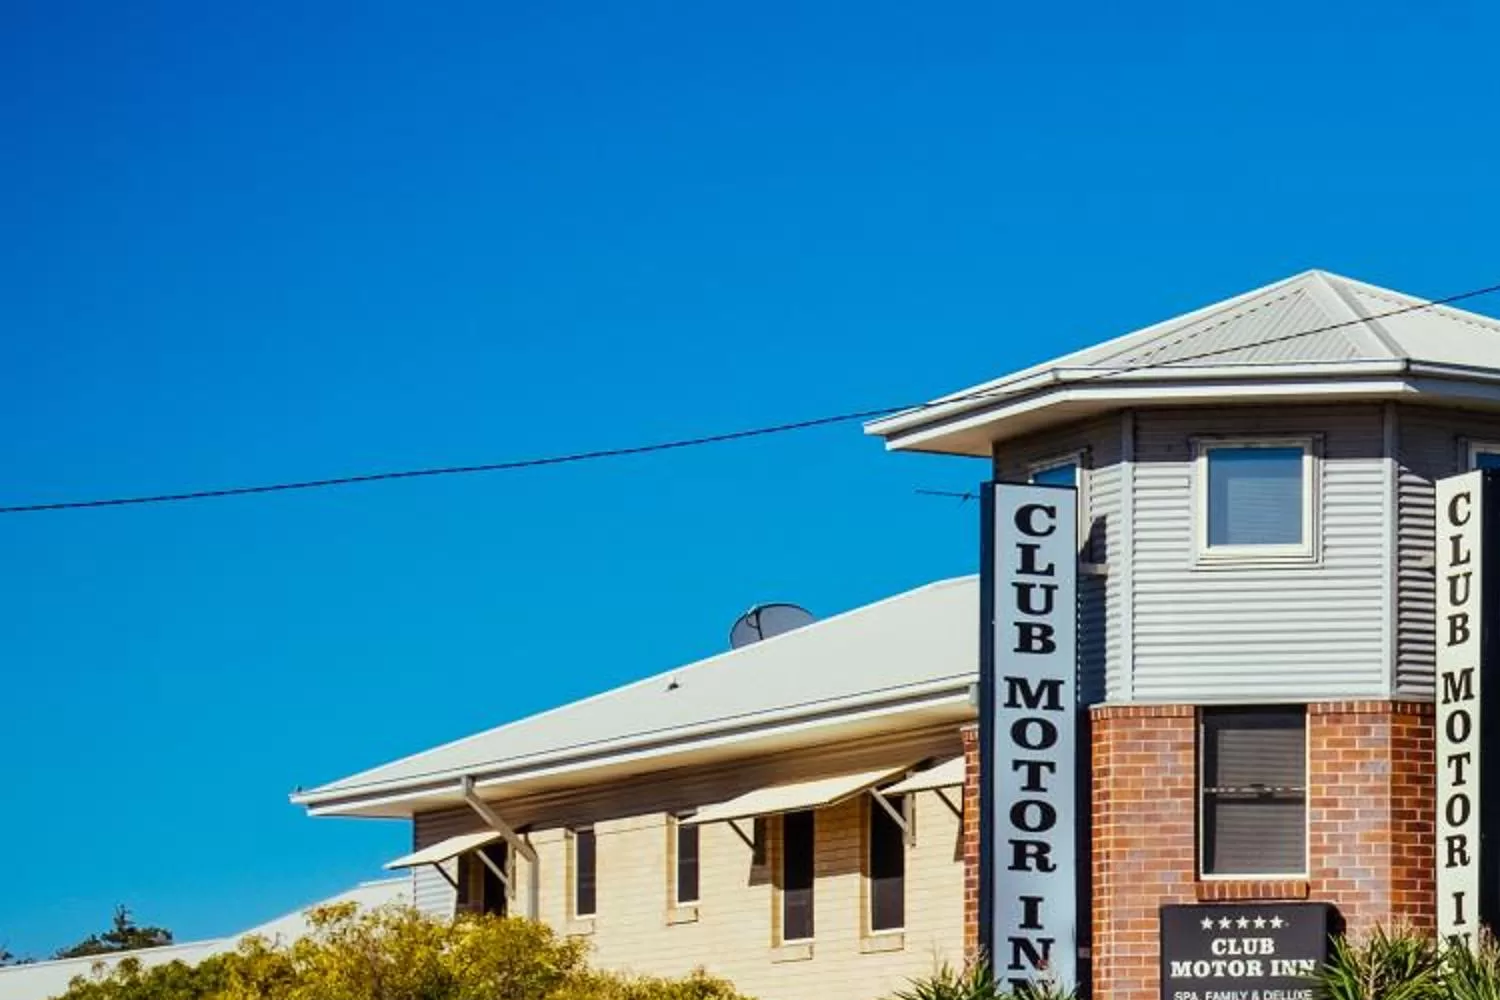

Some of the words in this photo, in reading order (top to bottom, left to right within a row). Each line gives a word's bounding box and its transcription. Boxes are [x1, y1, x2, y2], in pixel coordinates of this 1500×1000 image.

[1012, 503, 1058, 656] CLUB
[1446, 491, 1473, 648] CLUB
[1003, 676, 1064, 874] MOTOR
[1441, 666, 1476, 869] MOTOR
[1170, 959, 1264, 978] MOTOR
[1269, 959, 1317, 977] INN
[1211, 937, 1275, 955] CLUB
[1263, 989, 1314, 1000] DELUXE
